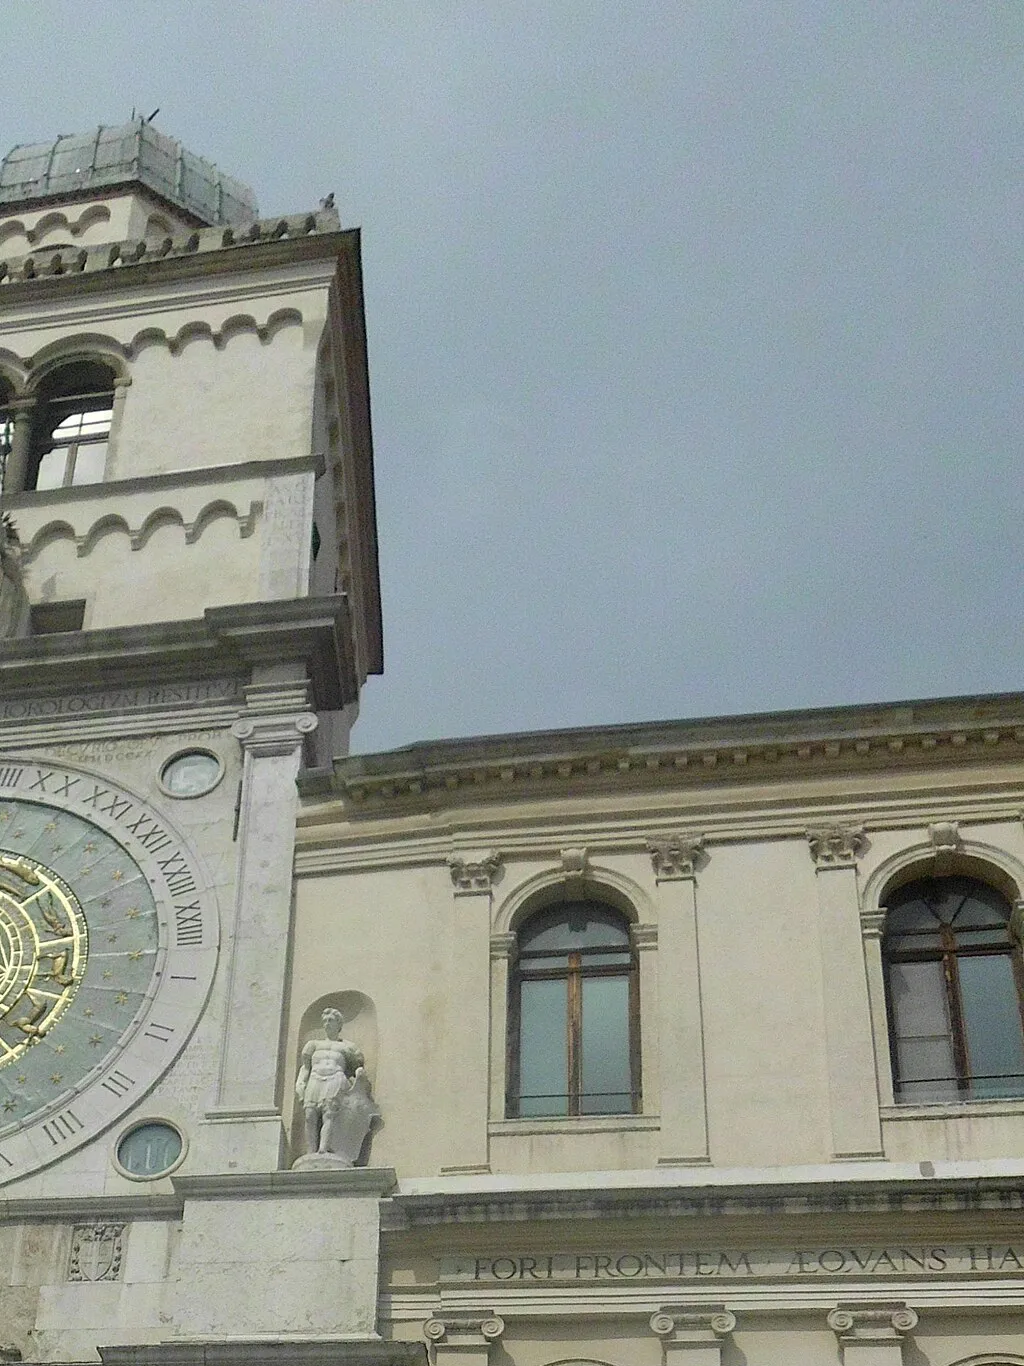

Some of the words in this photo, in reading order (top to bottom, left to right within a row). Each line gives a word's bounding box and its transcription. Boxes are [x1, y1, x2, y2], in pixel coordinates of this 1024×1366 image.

[29, 770, 81, 797] XX
[82, 785, 133, 820] XXI
[126, 813, 172, 854] XXII
[157, 851, 196, 897] XXIII
[174, 900, 203, 946] XXIIII
[144, 1022, 175, 1042] II
[102, 1070, 136, 1098] III
[42, 1110, 85, 1146] IIII
[474, 1255, 554, 1280] FORI
[575, 1252, 756, 1278] FRONTEM
